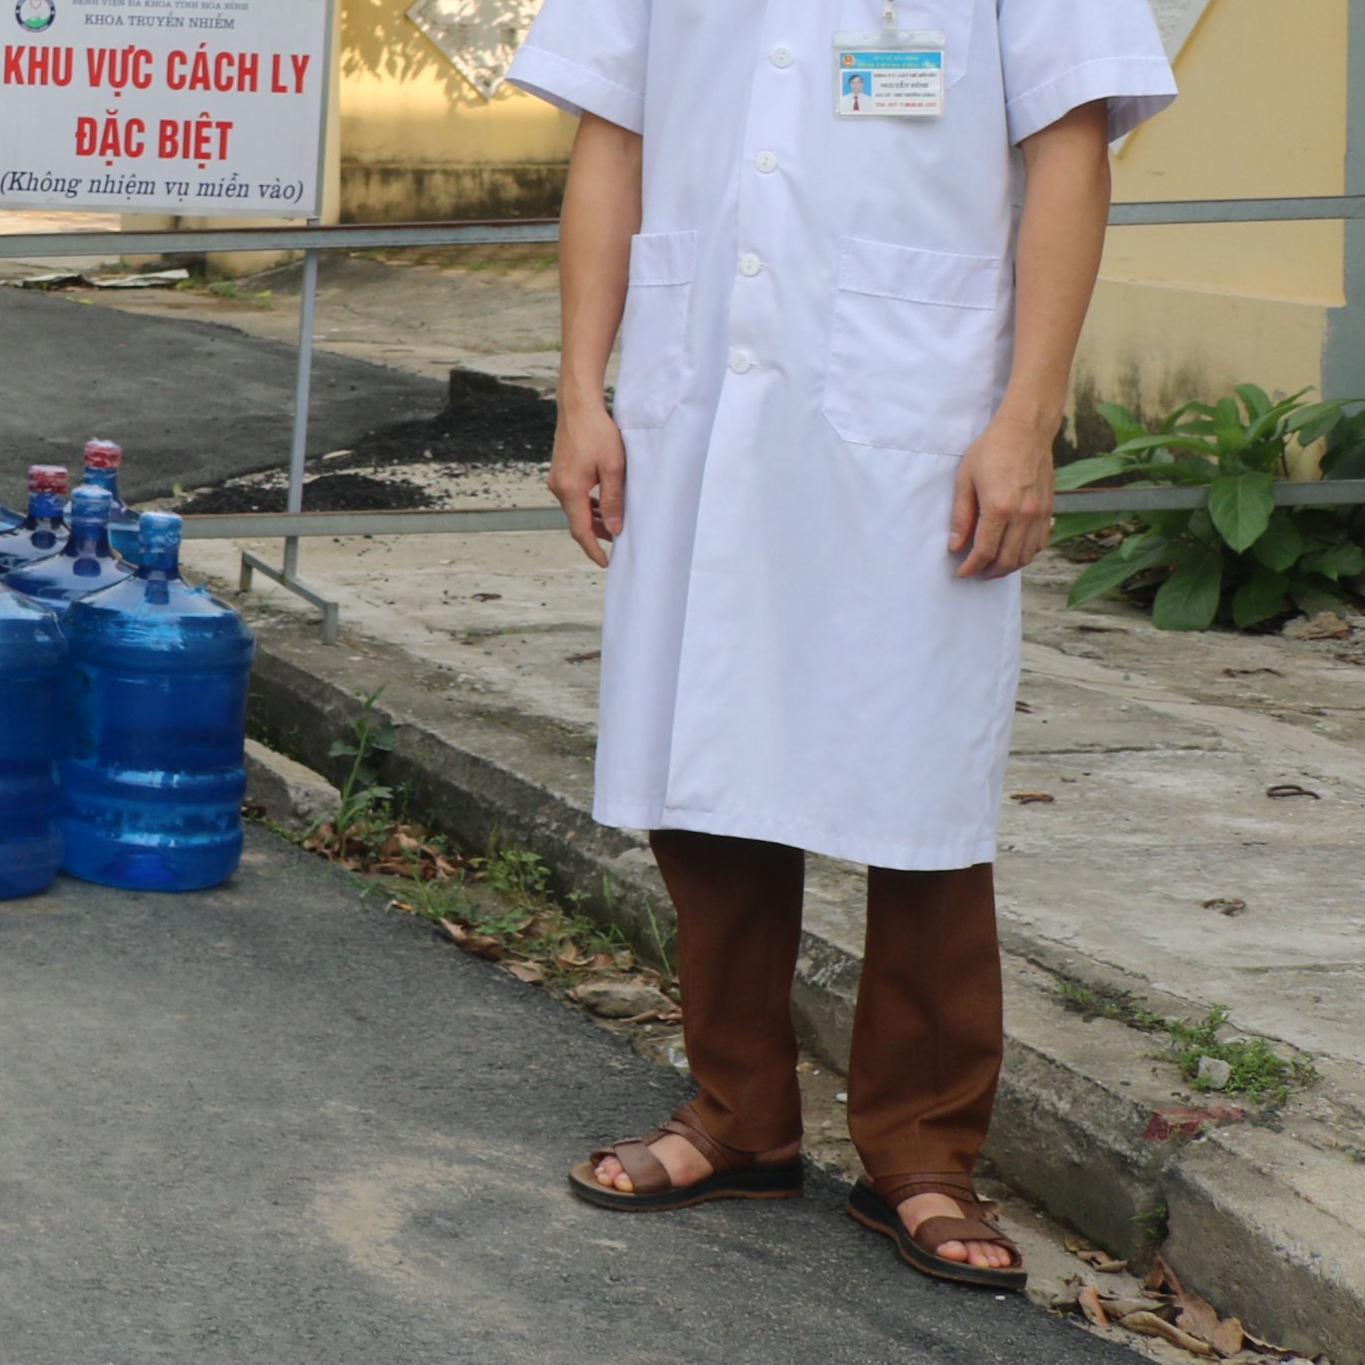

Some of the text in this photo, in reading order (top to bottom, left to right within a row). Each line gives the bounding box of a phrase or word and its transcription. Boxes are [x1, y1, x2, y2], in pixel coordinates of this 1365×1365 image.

[85, 11, 235, 29] KHOA TRUYỀN NHIỄM
[144, 0, 172, 8] KHOA
[3, 43, 310, 97] KHU VỰC CÁCH LY
[76, 109, 233, 169] ĐẶC BIỆT
[0, 171, 304, 204] (Không nhiệm vụ miễn vào)
